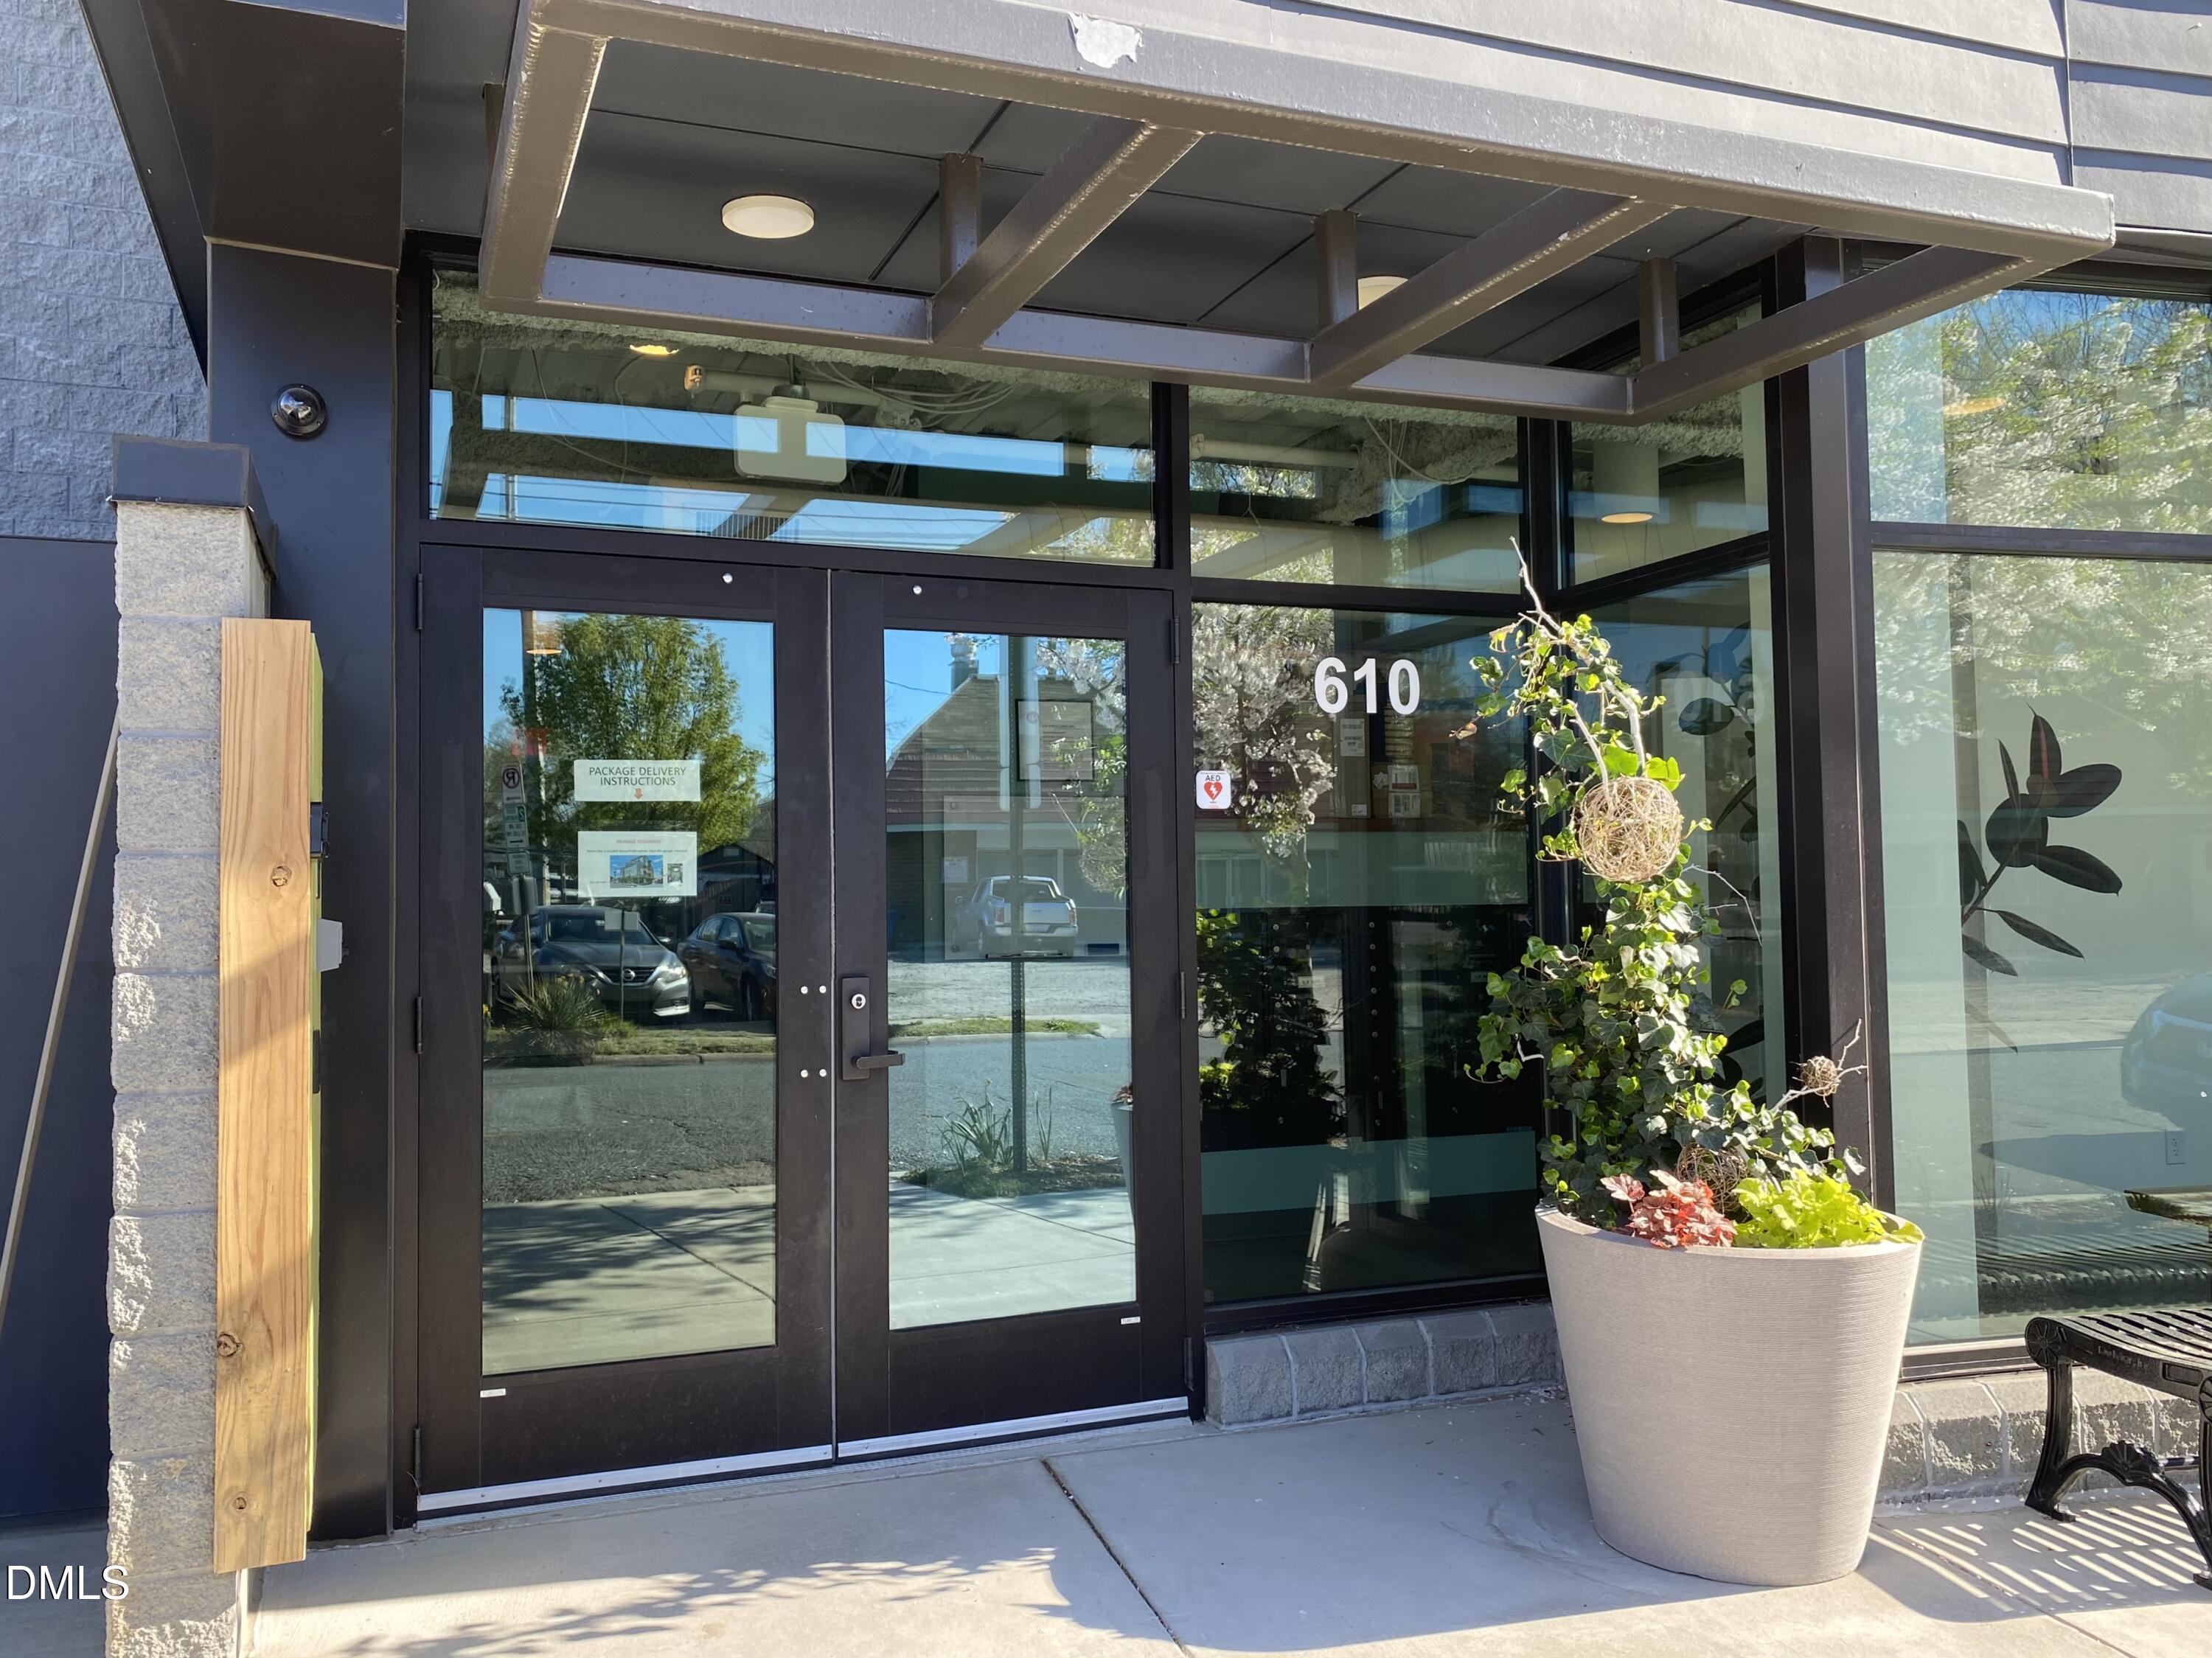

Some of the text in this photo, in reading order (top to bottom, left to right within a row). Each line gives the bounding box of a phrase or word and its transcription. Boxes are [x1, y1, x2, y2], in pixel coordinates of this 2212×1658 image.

[1314, 657, 1420, 714] 610
[589, 767, 686, 776] PACKAGE DELIVERY
[600, 777, 676, 786] INSTRUCTIONS
